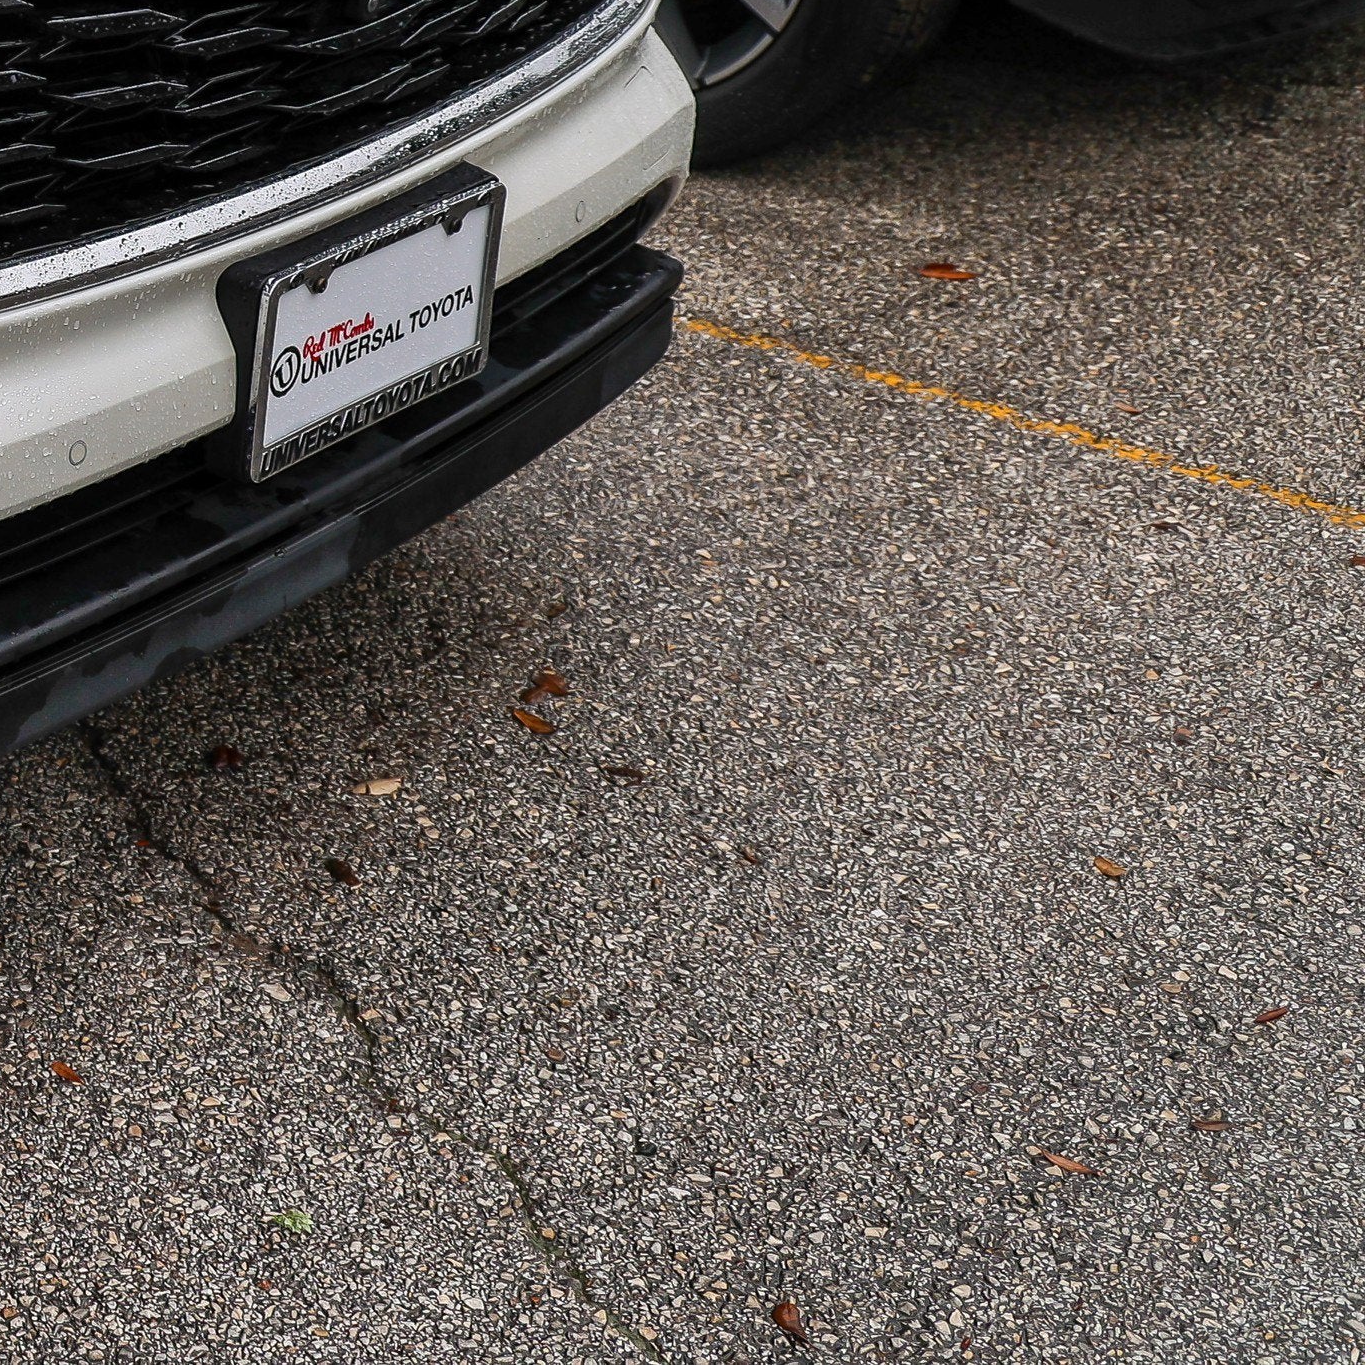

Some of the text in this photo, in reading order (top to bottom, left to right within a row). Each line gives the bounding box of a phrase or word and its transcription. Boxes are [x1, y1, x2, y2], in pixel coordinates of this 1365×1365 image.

[301, 284, 474, 384] UNIVERSAL TOYOTA
[303, 331, 326, 362] Red
[261, 346, 483, 474] UNIVERSALTOYOTA.COM
